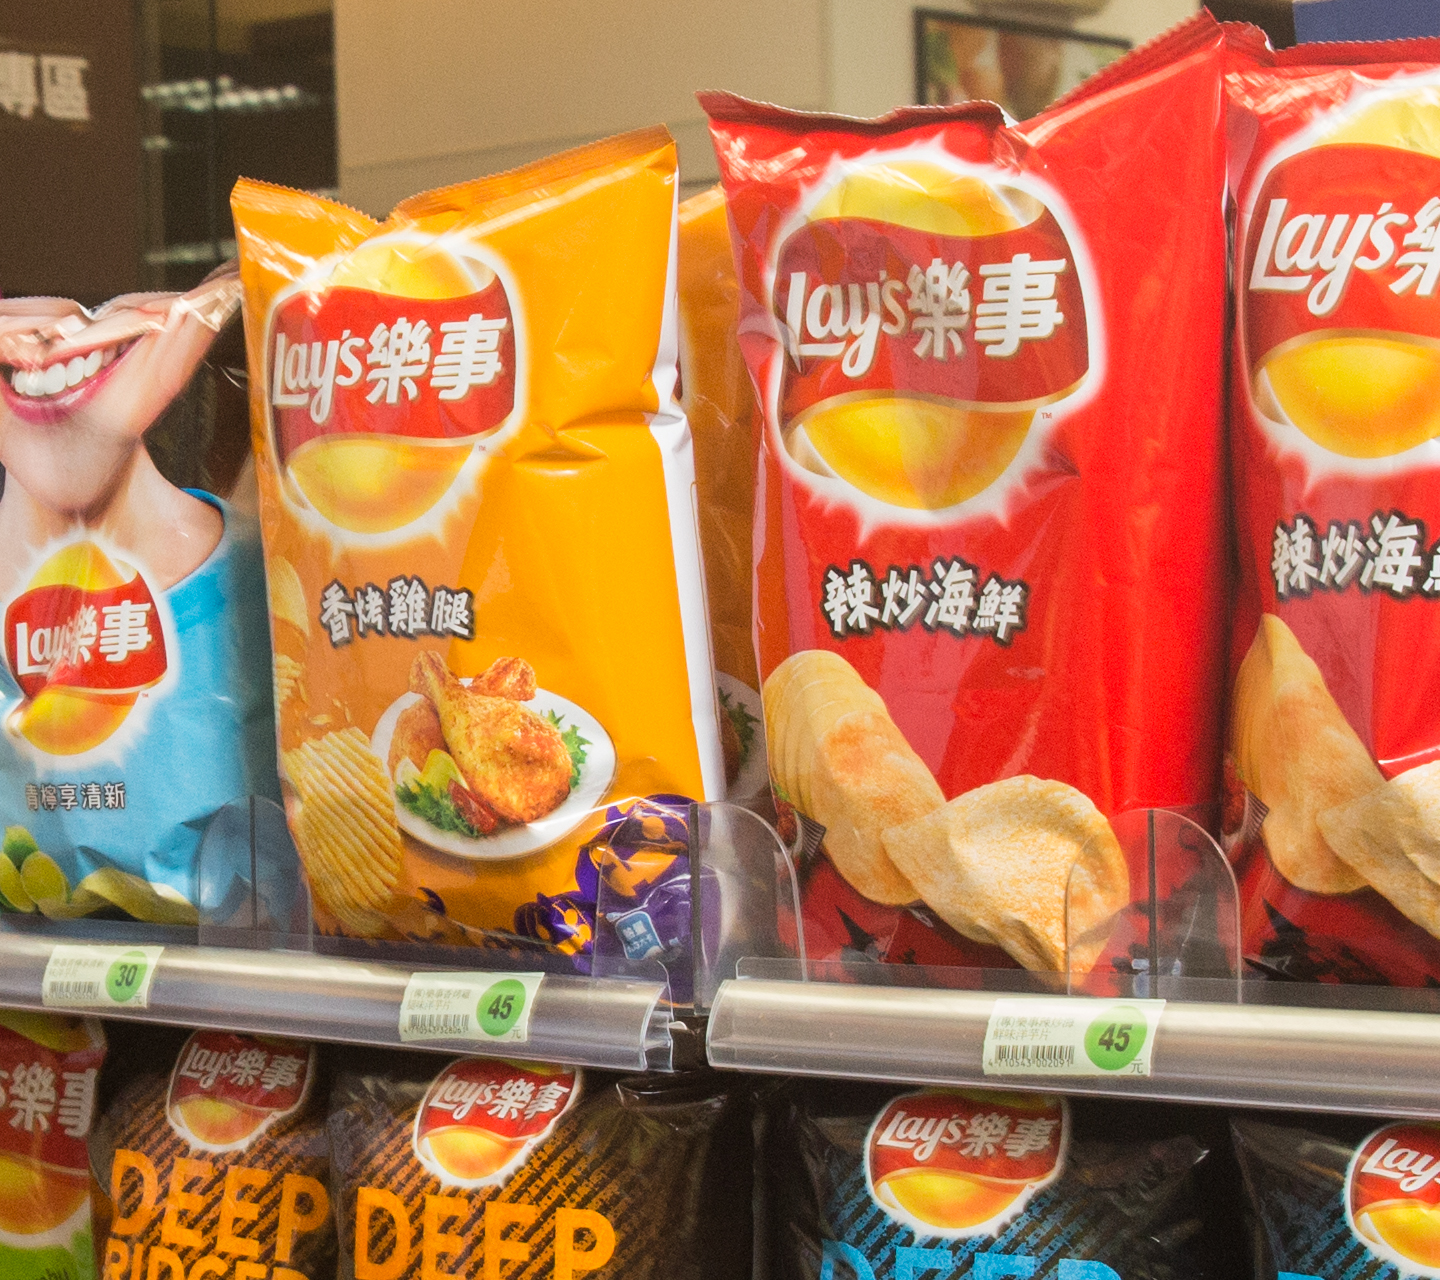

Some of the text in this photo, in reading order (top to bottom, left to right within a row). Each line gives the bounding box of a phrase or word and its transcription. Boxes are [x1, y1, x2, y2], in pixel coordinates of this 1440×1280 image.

[785, 252, 1068, 379] Lay's樂事
[272, 314, 509, 426] Lay's樂事
[320, 575, 477, 647] 香烤雞腿
[823, 559, 1030, 644] 辣炒海鮮
[115, 964, 138, 987] 30
[487, 994, 515, 1020] 45
[178, 1038, 304, 1093] Lay's樂事
[1097, 1022, 1133, 1053] 45
[1131, 1058, 1144, 1075] 元
[429, 1070, 573, 1124] Lay's樂事
[878, 1105, 1060, 1162] Lay's樂事
[112, 1148, 331, 1264] DEEP
